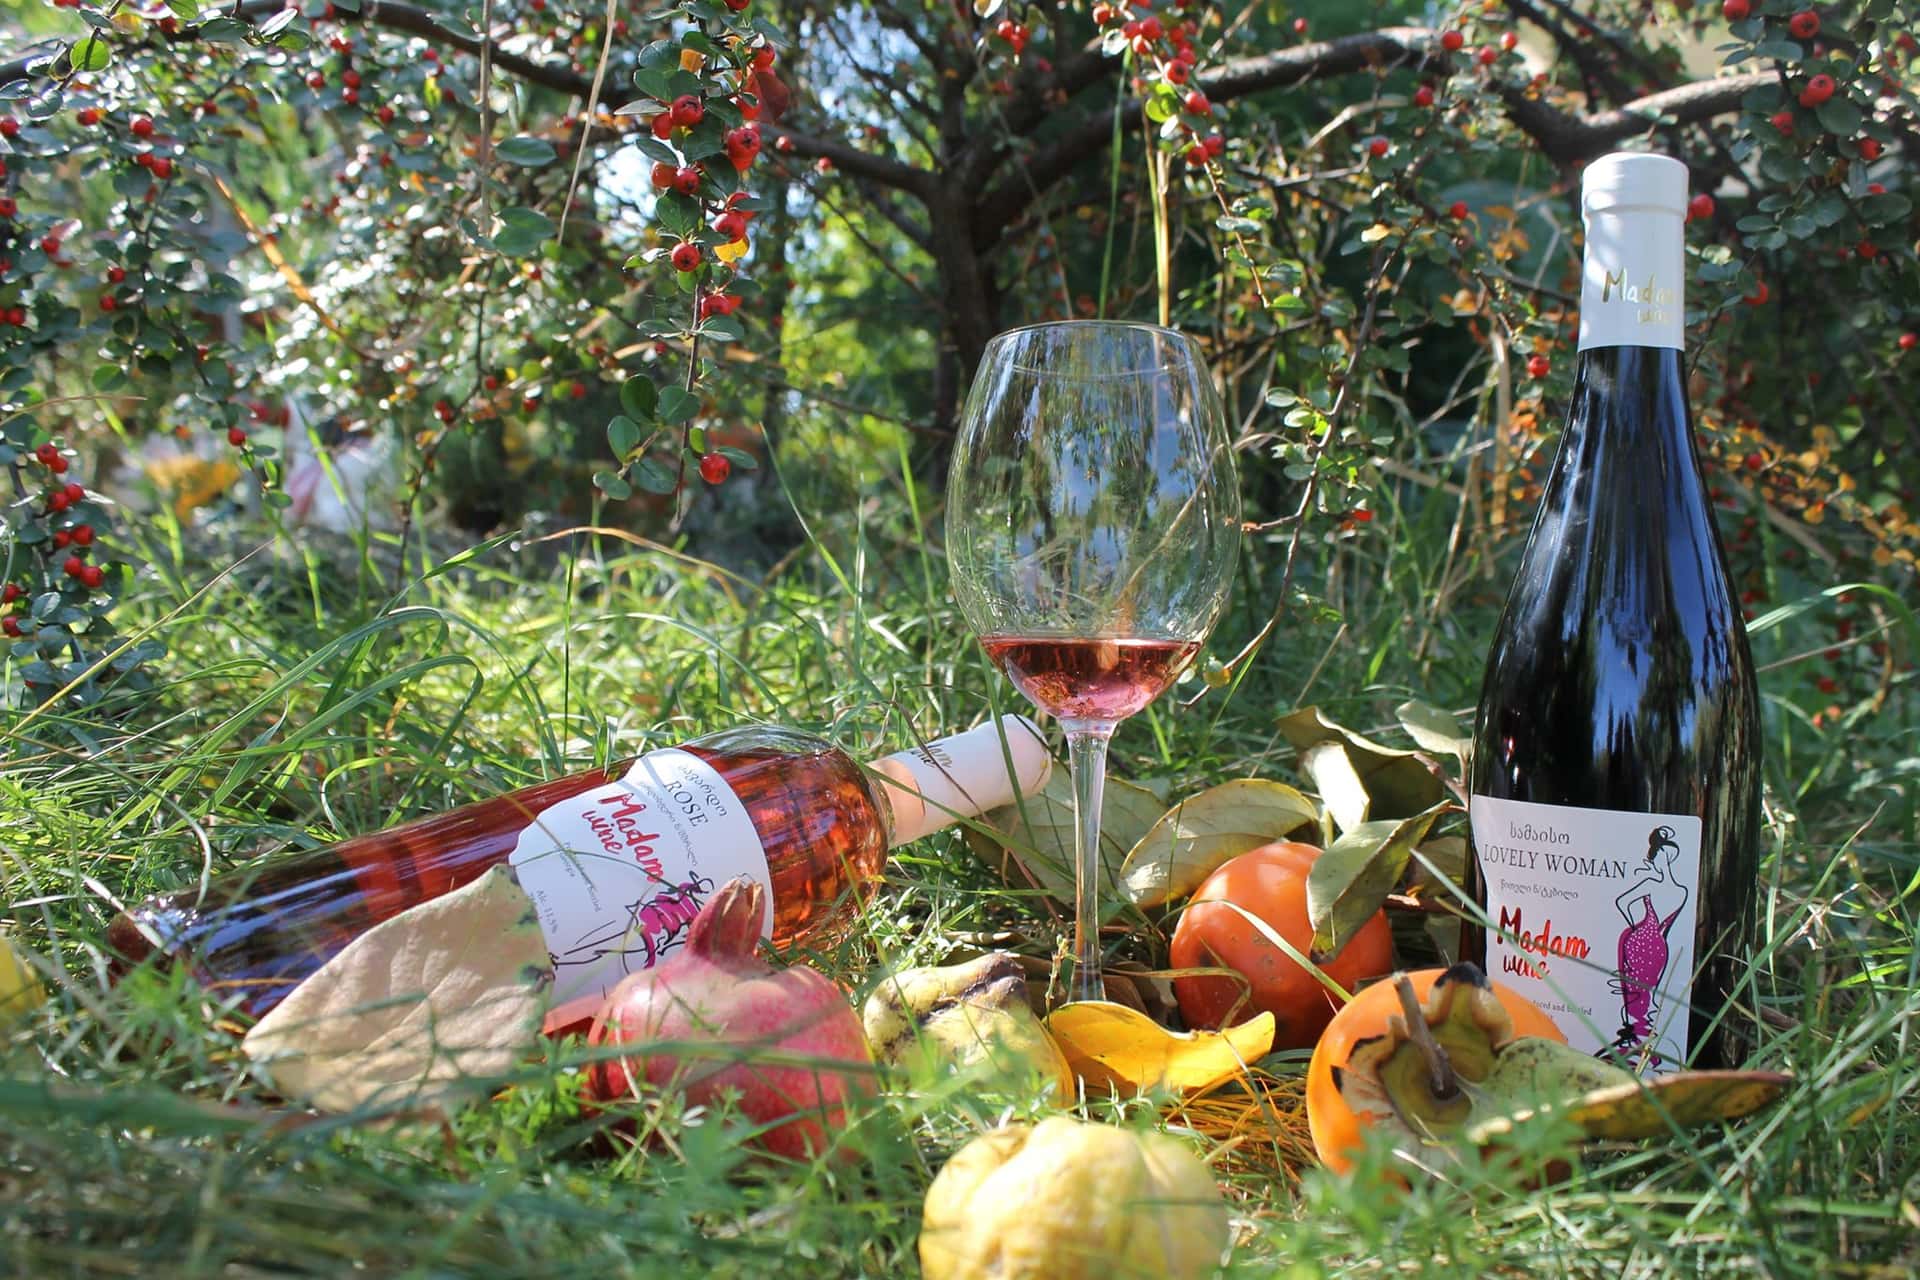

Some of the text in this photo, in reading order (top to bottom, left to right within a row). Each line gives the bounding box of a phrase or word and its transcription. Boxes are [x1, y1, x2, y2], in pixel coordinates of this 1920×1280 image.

[664, 780, 709, 827] ROSE
[581, 810, 623, 855] wine
[598, 792, 665, 884] Madam
[1510, 821, 1570, 845] სამაისო
[1484, 844, 1627, 879] LOVELY WOMAN
[1497, 905, 1591, 960] Madam
[1503, 955, 1550, 980] wine
